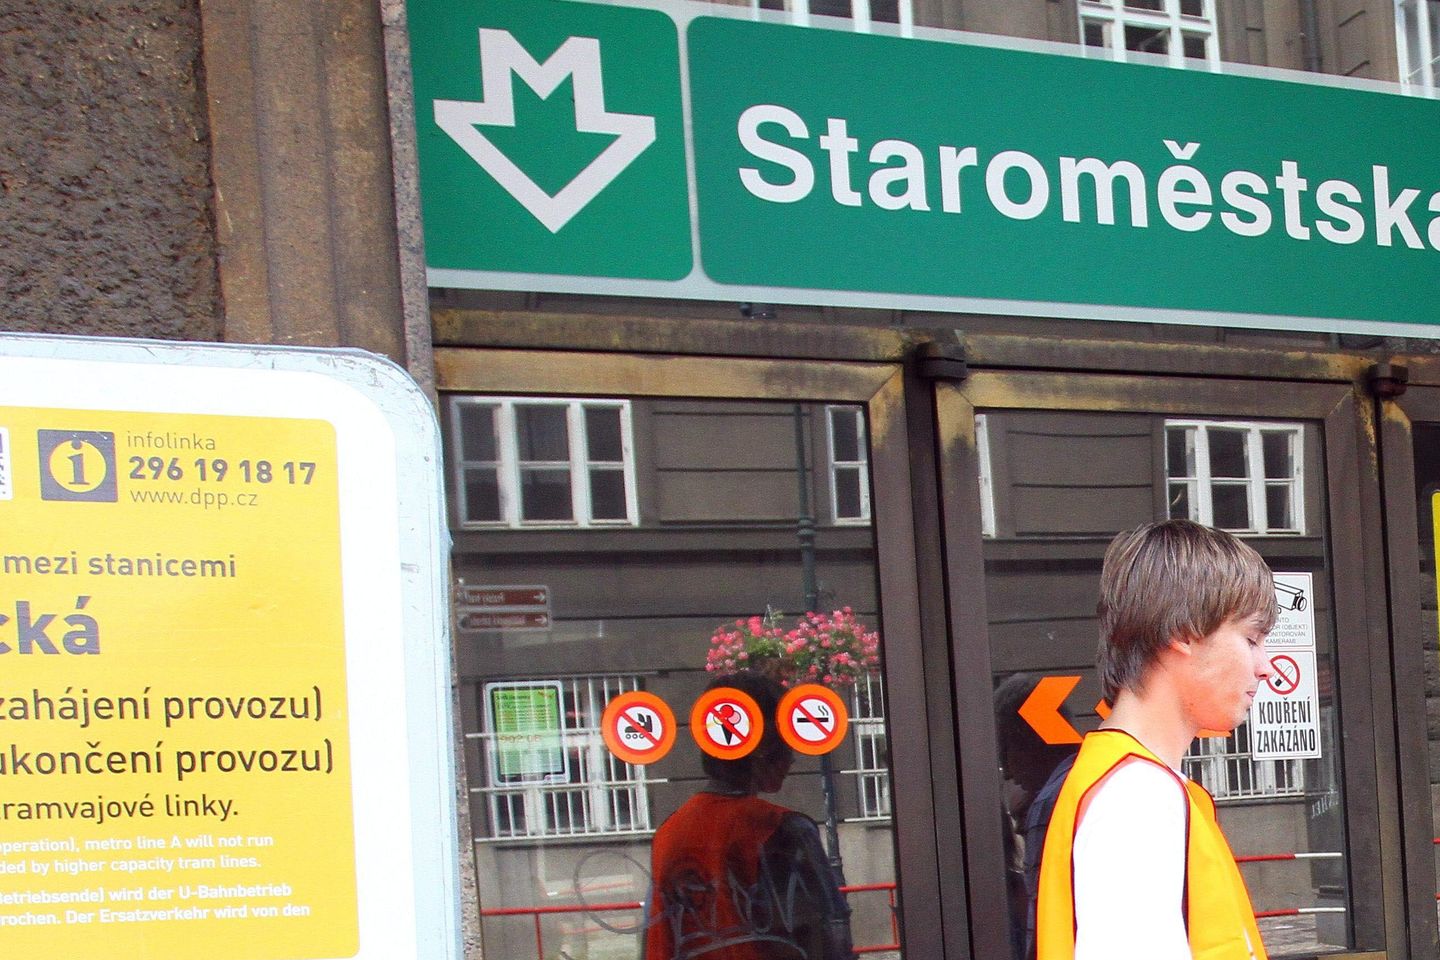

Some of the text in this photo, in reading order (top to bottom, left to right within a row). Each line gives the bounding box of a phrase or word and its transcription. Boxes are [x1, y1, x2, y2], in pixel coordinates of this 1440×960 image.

[127, 431, 217, 451] infolinka
[129, 455, 317, 485] 296 19 18 17
[131, 487, 259, 510] www.dpp.cz
[3, 549, 237, 578] mezi stanicemi
[163, 684, 323, 728] provozu)
[1258, 697, 1312, 725] KOUŘENÍ
[1256, 724, 1316, 753] ZAKÁZÁNO
[176, 737, 334, 781] provozu)
[0, 792, 239, 824] ramvajové linky.
[84, 838, 132, 850] metro
[136, 835, 166, 849] line
[170, 835, 182, 849] A
[185, 834, 214, 848] will
[218, 835, 243, 847] not
[247, 836, 274, 847] run
[31, 859, 50, 876] by
[53, 859, 106, 875] higher
[110, 857, 175, 873] capacity
[178, 857, 215, 869] tram
[220, 854, 262, 868] lines.
[109, 887, 144, 901] wird
[147, 886, 175, 900] der
[178, 883, 292, 899] U-Bahnbetrieb
[65, 909, 95, 924] Der
[99, 906, 211, 923] Ersatzverkehr
[214, 905, 248, 918] wird
[251, 906, 278, 917] von
[282, 903, 310, 916] den
